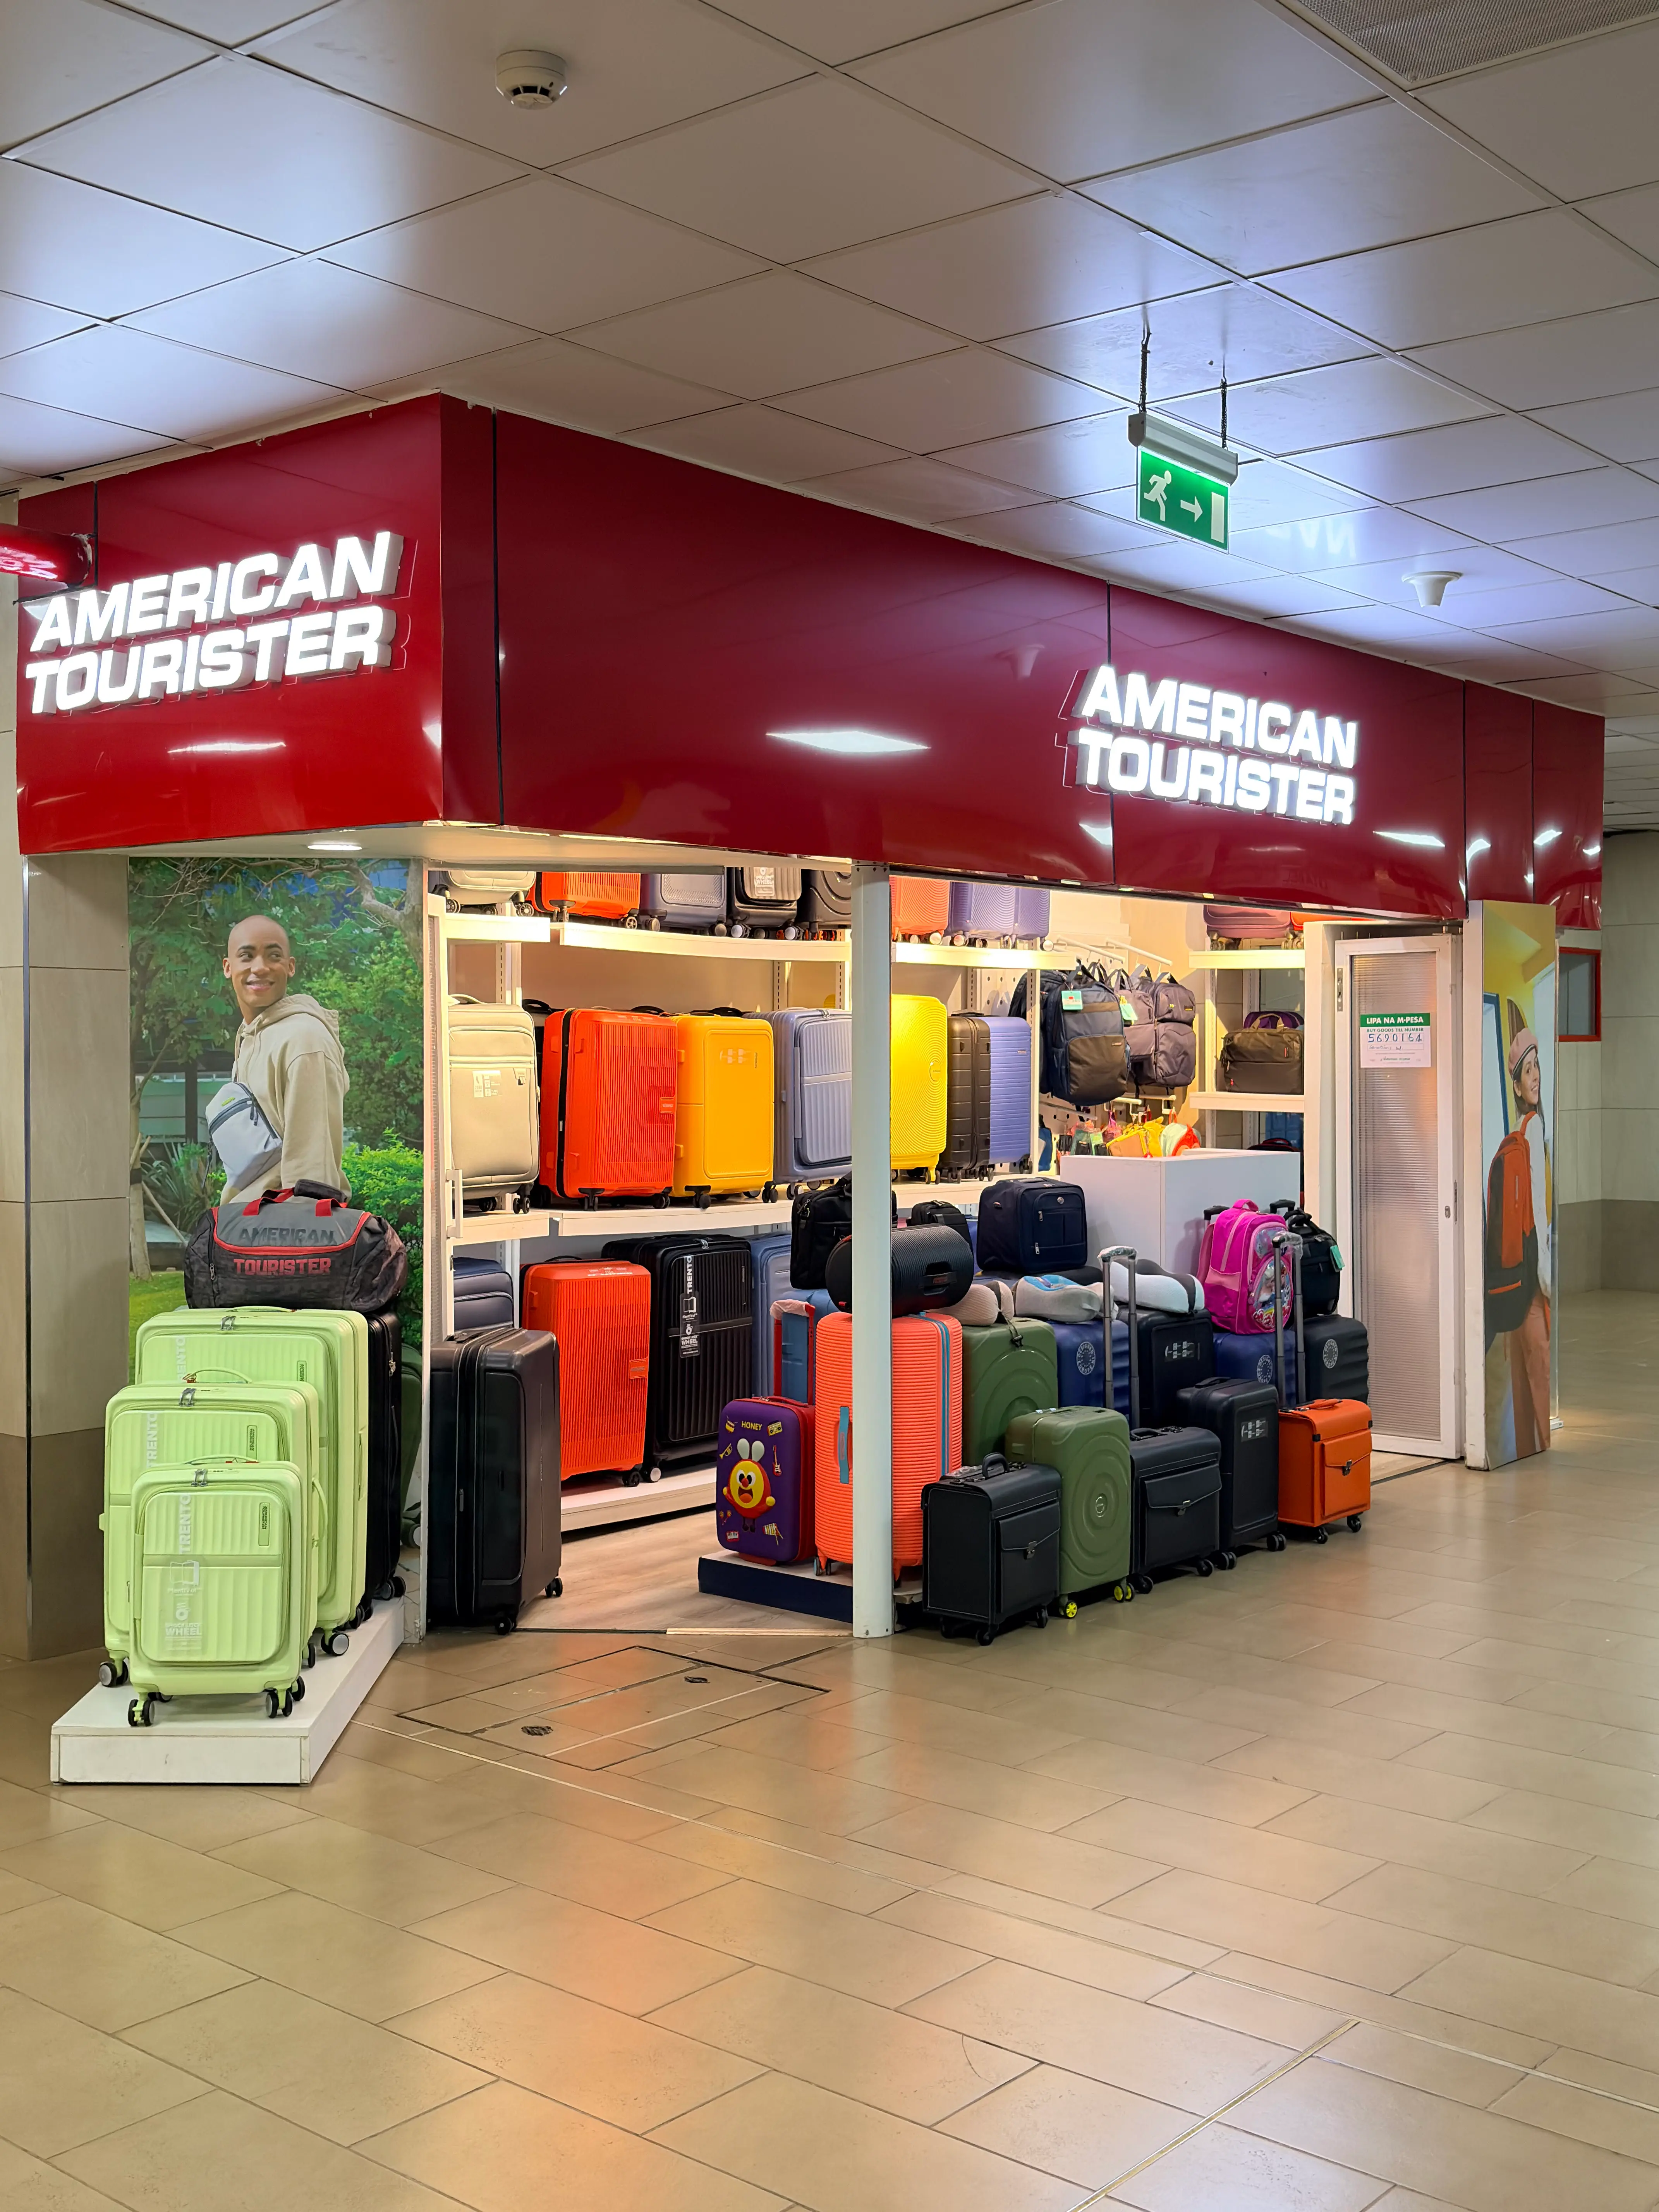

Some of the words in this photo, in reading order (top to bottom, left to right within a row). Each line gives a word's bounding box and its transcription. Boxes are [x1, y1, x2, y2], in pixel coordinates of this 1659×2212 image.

[31, 531, 399, 652] AMERICAN
[25, 605, 393, 714] TOURISTER
[1076, 665, 1358, 768] AMERICAN
[1072, 728, 1355, 824] TOURISTER
[237, 1227, 335, 1245] AMERICAN
[233, 1258, 331, 1276] TOURISTER
[176, 1336, 187, 1383] RENTO
[147, 1413, 158, 1468] TRENTO
[742, 1421, 763, 1431] HONEY
[179, 1494, 191, 1554] TRENTO
[165, 1627, 202, 1636] WHEEL
